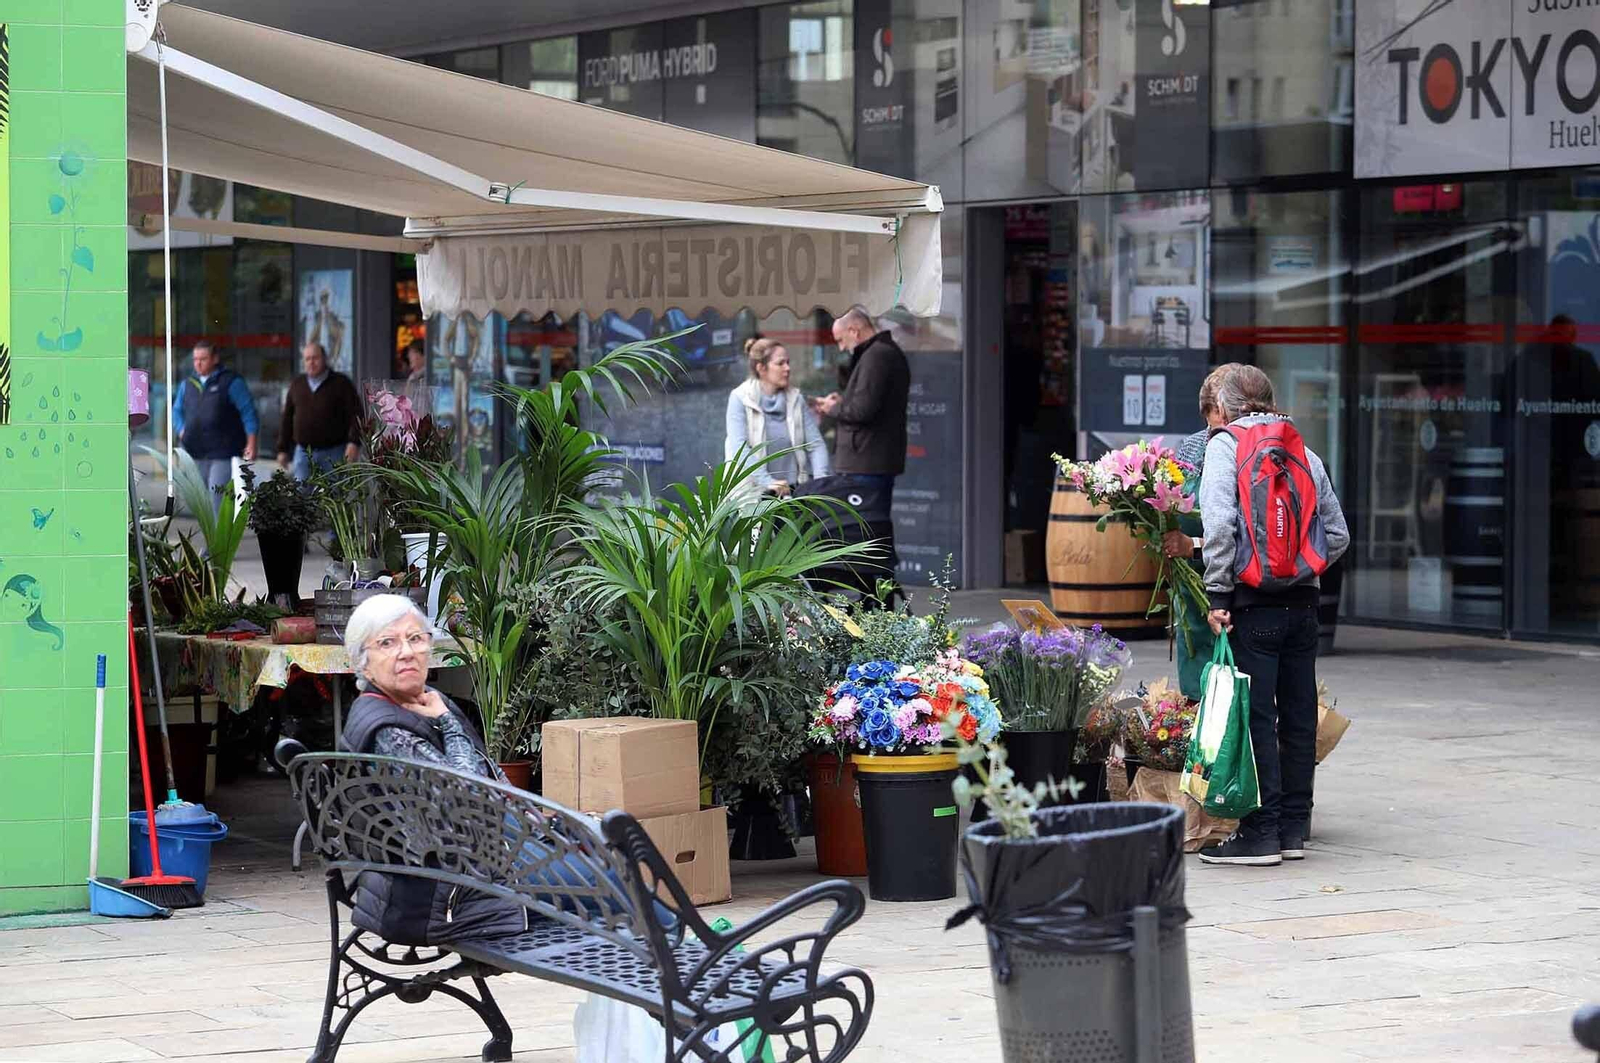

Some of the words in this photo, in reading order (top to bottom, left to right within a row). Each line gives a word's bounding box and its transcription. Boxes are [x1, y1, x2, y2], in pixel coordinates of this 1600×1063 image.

[619, 51, 661, 82] PUMA
[663, 43, 717, 78] HYBRID
[1388, 29, 1600, 125] TOKYO
[1550, 115, 1600, 149] Huel
[1358, 395, 1438, 412] Ayuntamiento
[1440, 396, 1456, 411] de
[1457, 397, 1501, 412] Huelva
